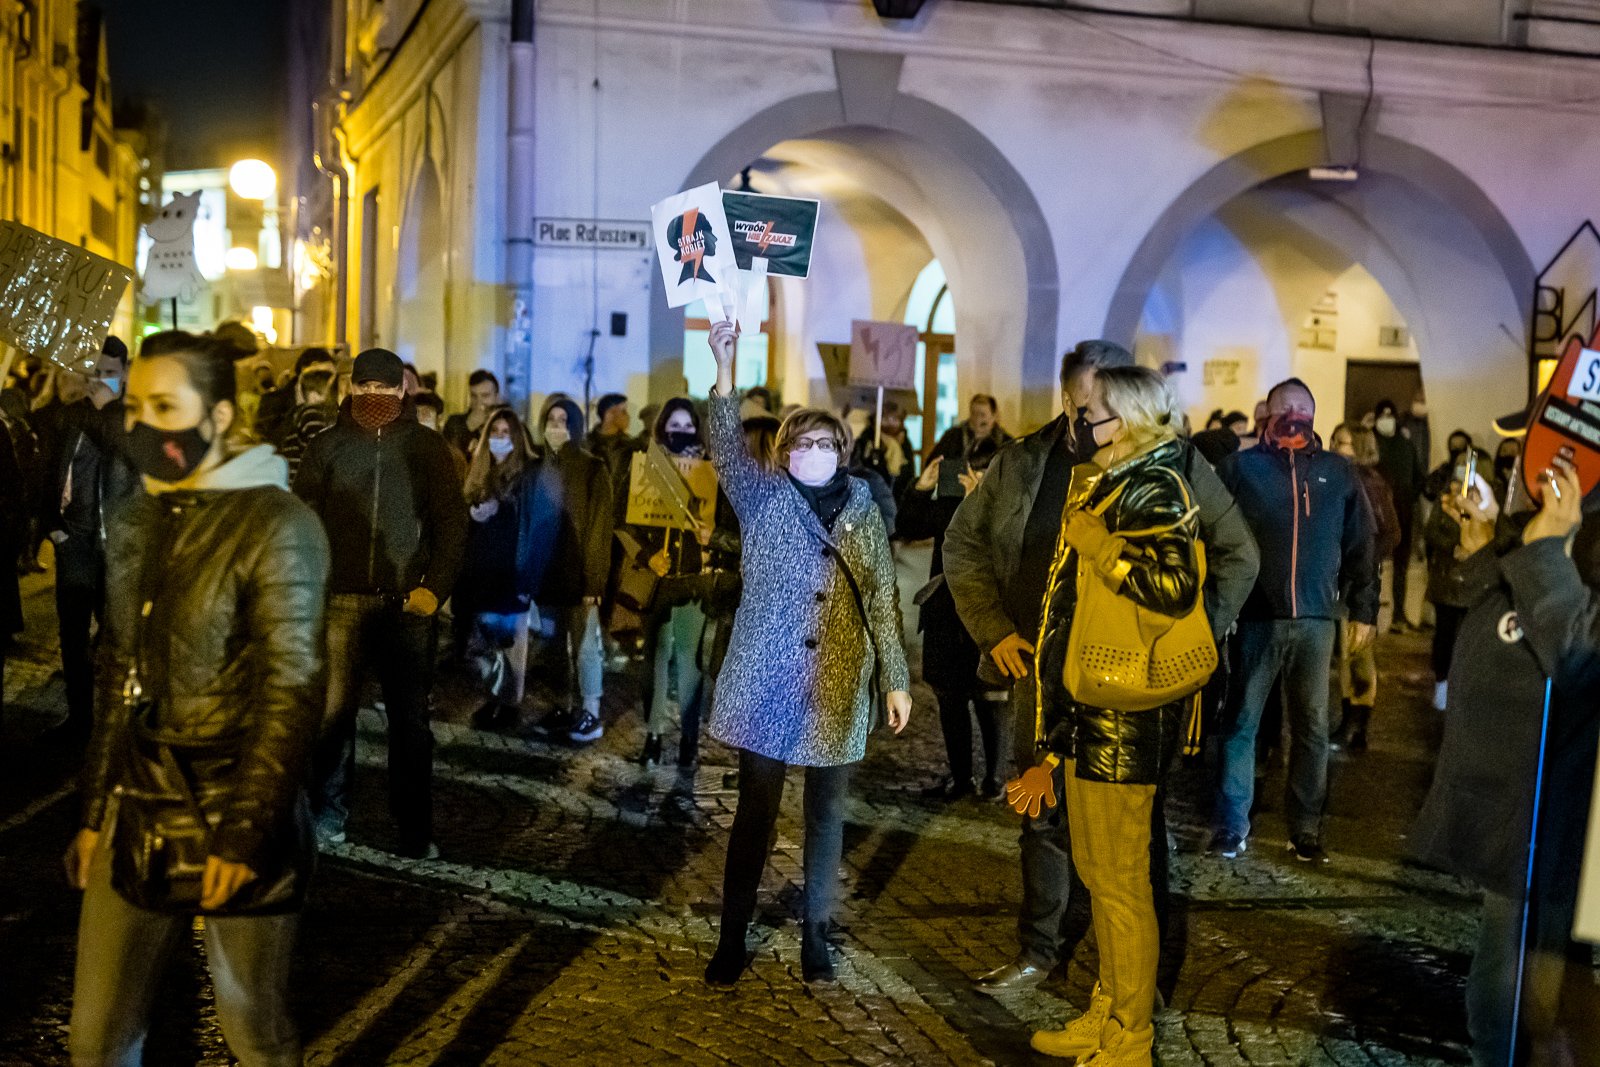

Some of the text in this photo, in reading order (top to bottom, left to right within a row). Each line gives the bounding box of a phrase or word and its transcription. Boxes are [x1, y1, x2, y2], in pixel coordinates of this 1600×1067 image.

[539, 223, 647, 247] Plac Ratuszowy
[736, 221, 765, 232] WYBÓR
[677, 230, 705, 248] STRAJK
[747, 231, 793, 244] NIE ZAKAZ
[680, 239, 706, 257] KOBIET
